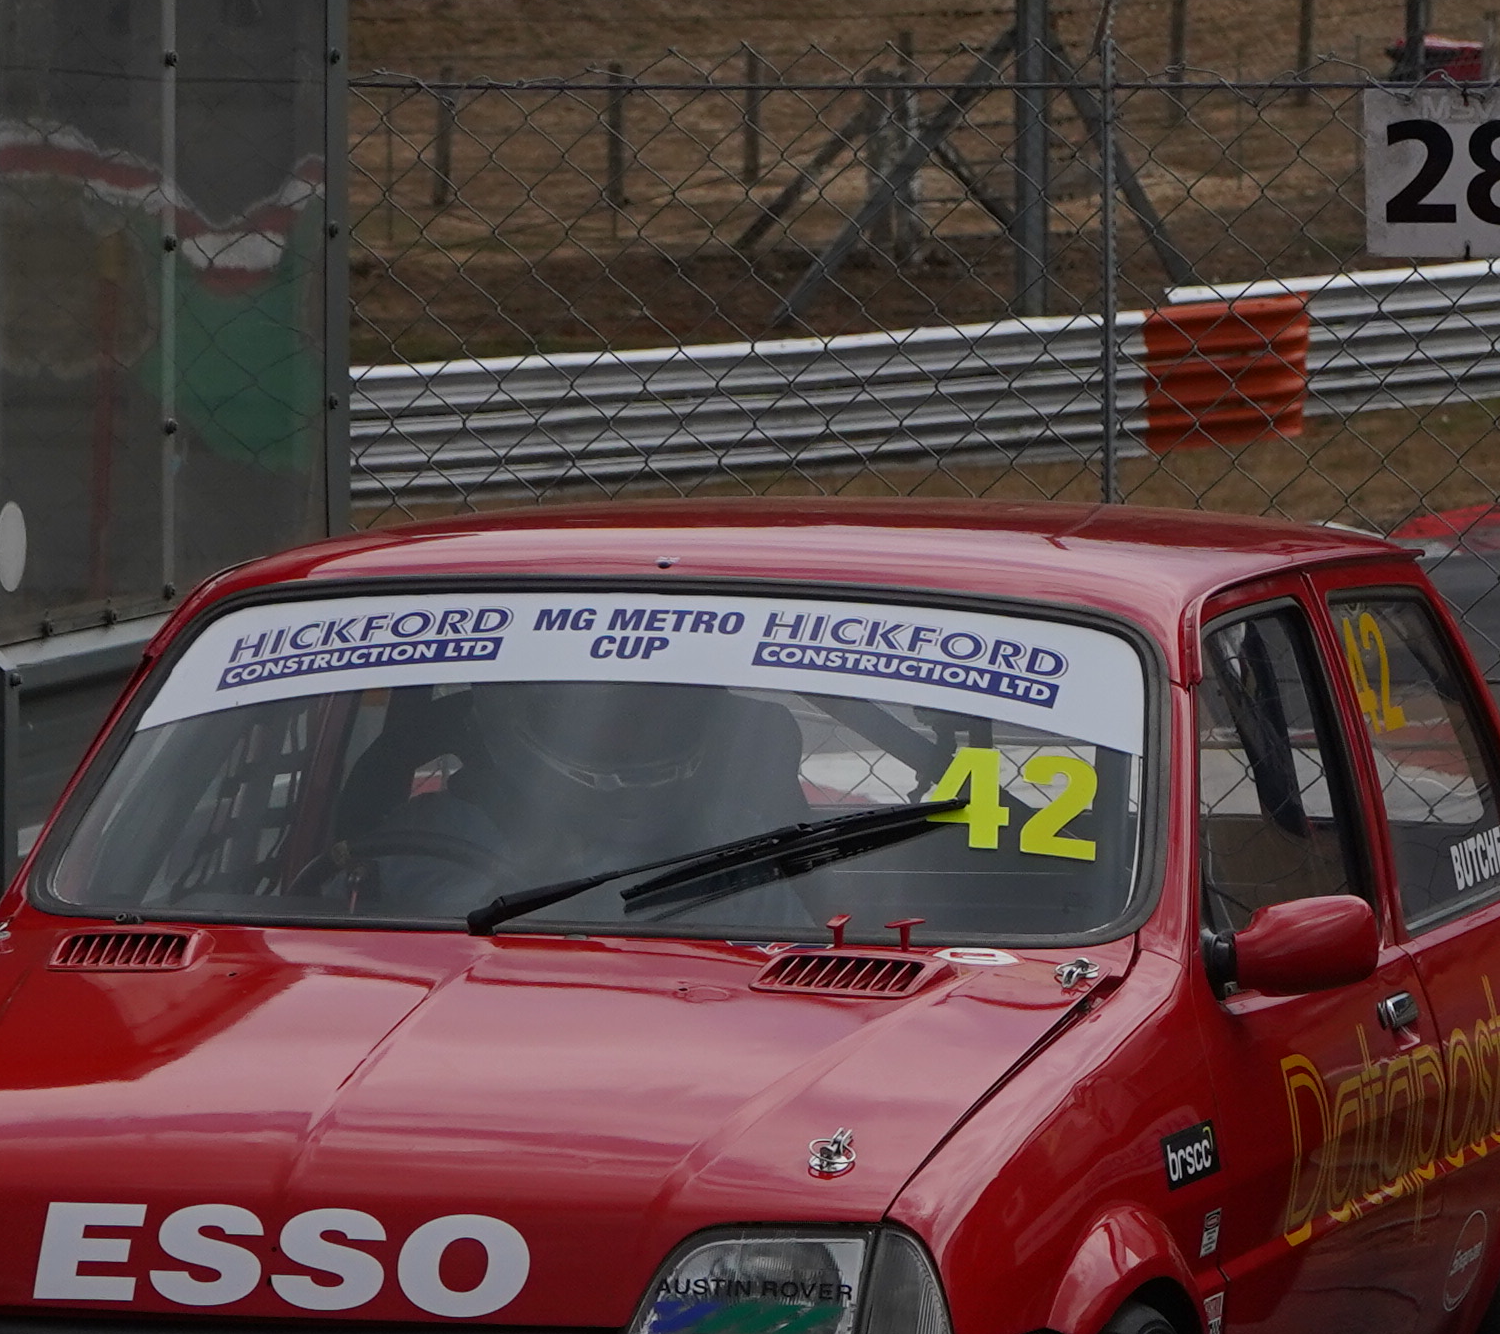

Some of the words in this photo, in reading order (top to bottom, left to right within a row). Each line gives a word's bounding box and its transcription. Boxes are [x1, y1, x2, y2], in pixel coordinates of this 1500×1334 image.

[228, 606, 514, 664] HICKFORD
[533, 609, 597, 632] MG
[610, 609, 745, 635] METRO
[590, 636, 669, 660] CUP
[762, 611, 1069, 679] HICKFORD
[224, 642, 435, 684] CONSTRUCTION
[444, 638, 495, 661] LTD
[760, 645, 991, 689] CONSTRUCTION
[1000, 675, 1053, 702] LTD
[1343, 613, 1405, 733] 42
[926, 747, 1098, 861] 42
[1166, 1138, 1212, 1182] brscc
[32, 1201, 531, 1319] ESSO
[658, 1277, 752, 1298] AUSTIN
[762, 1279, 853, 1301] ROVER
